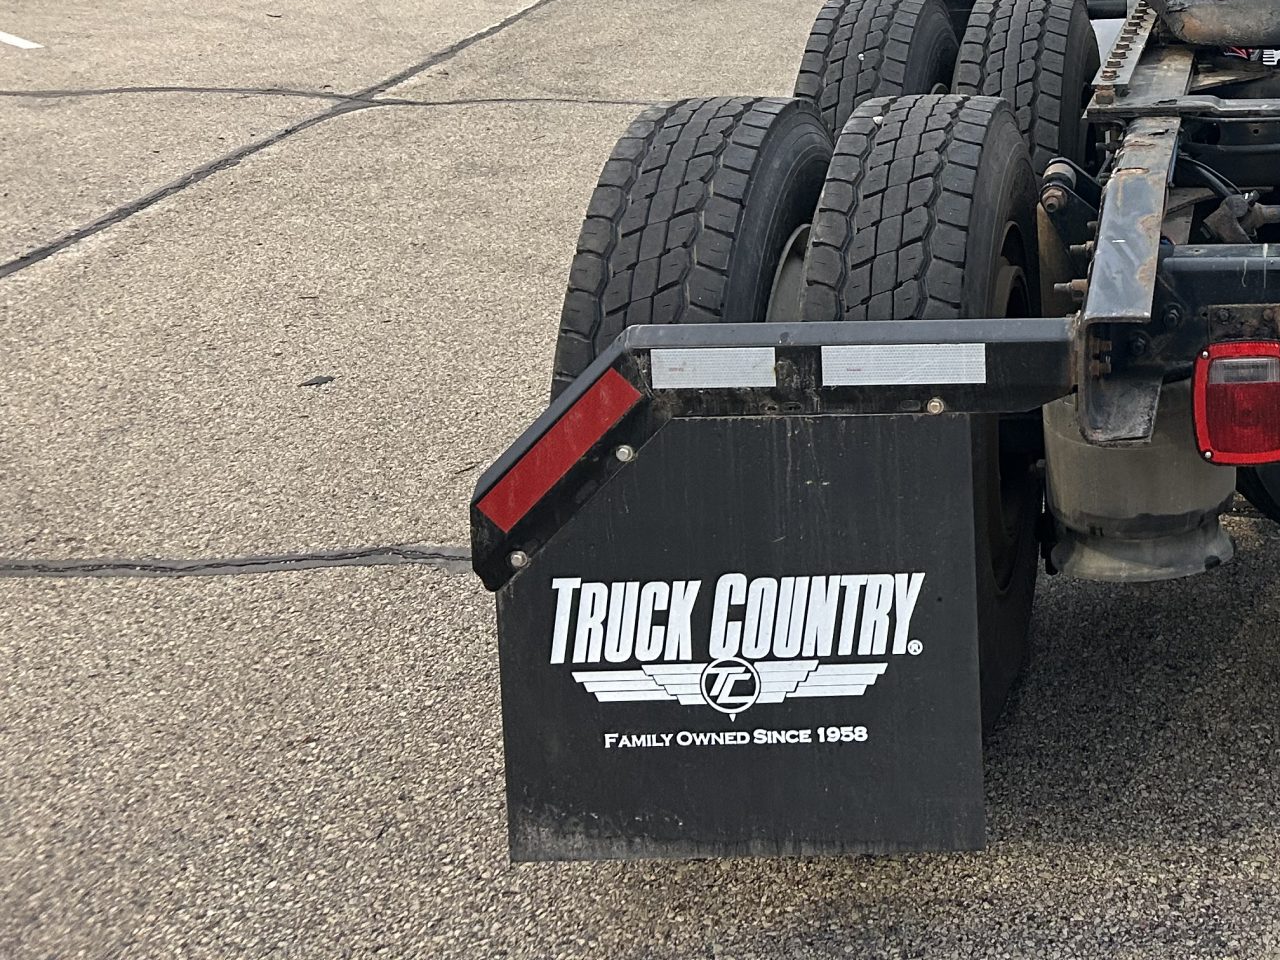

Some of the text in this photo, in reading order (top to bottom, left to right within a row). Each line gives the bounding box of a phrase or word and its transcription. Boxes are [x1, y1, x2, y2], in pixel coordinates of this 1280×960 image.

[550, 577, 702, 664] TRUCK
[604, 726, 868, 749] FAMILY OWNED SINCE 1958
